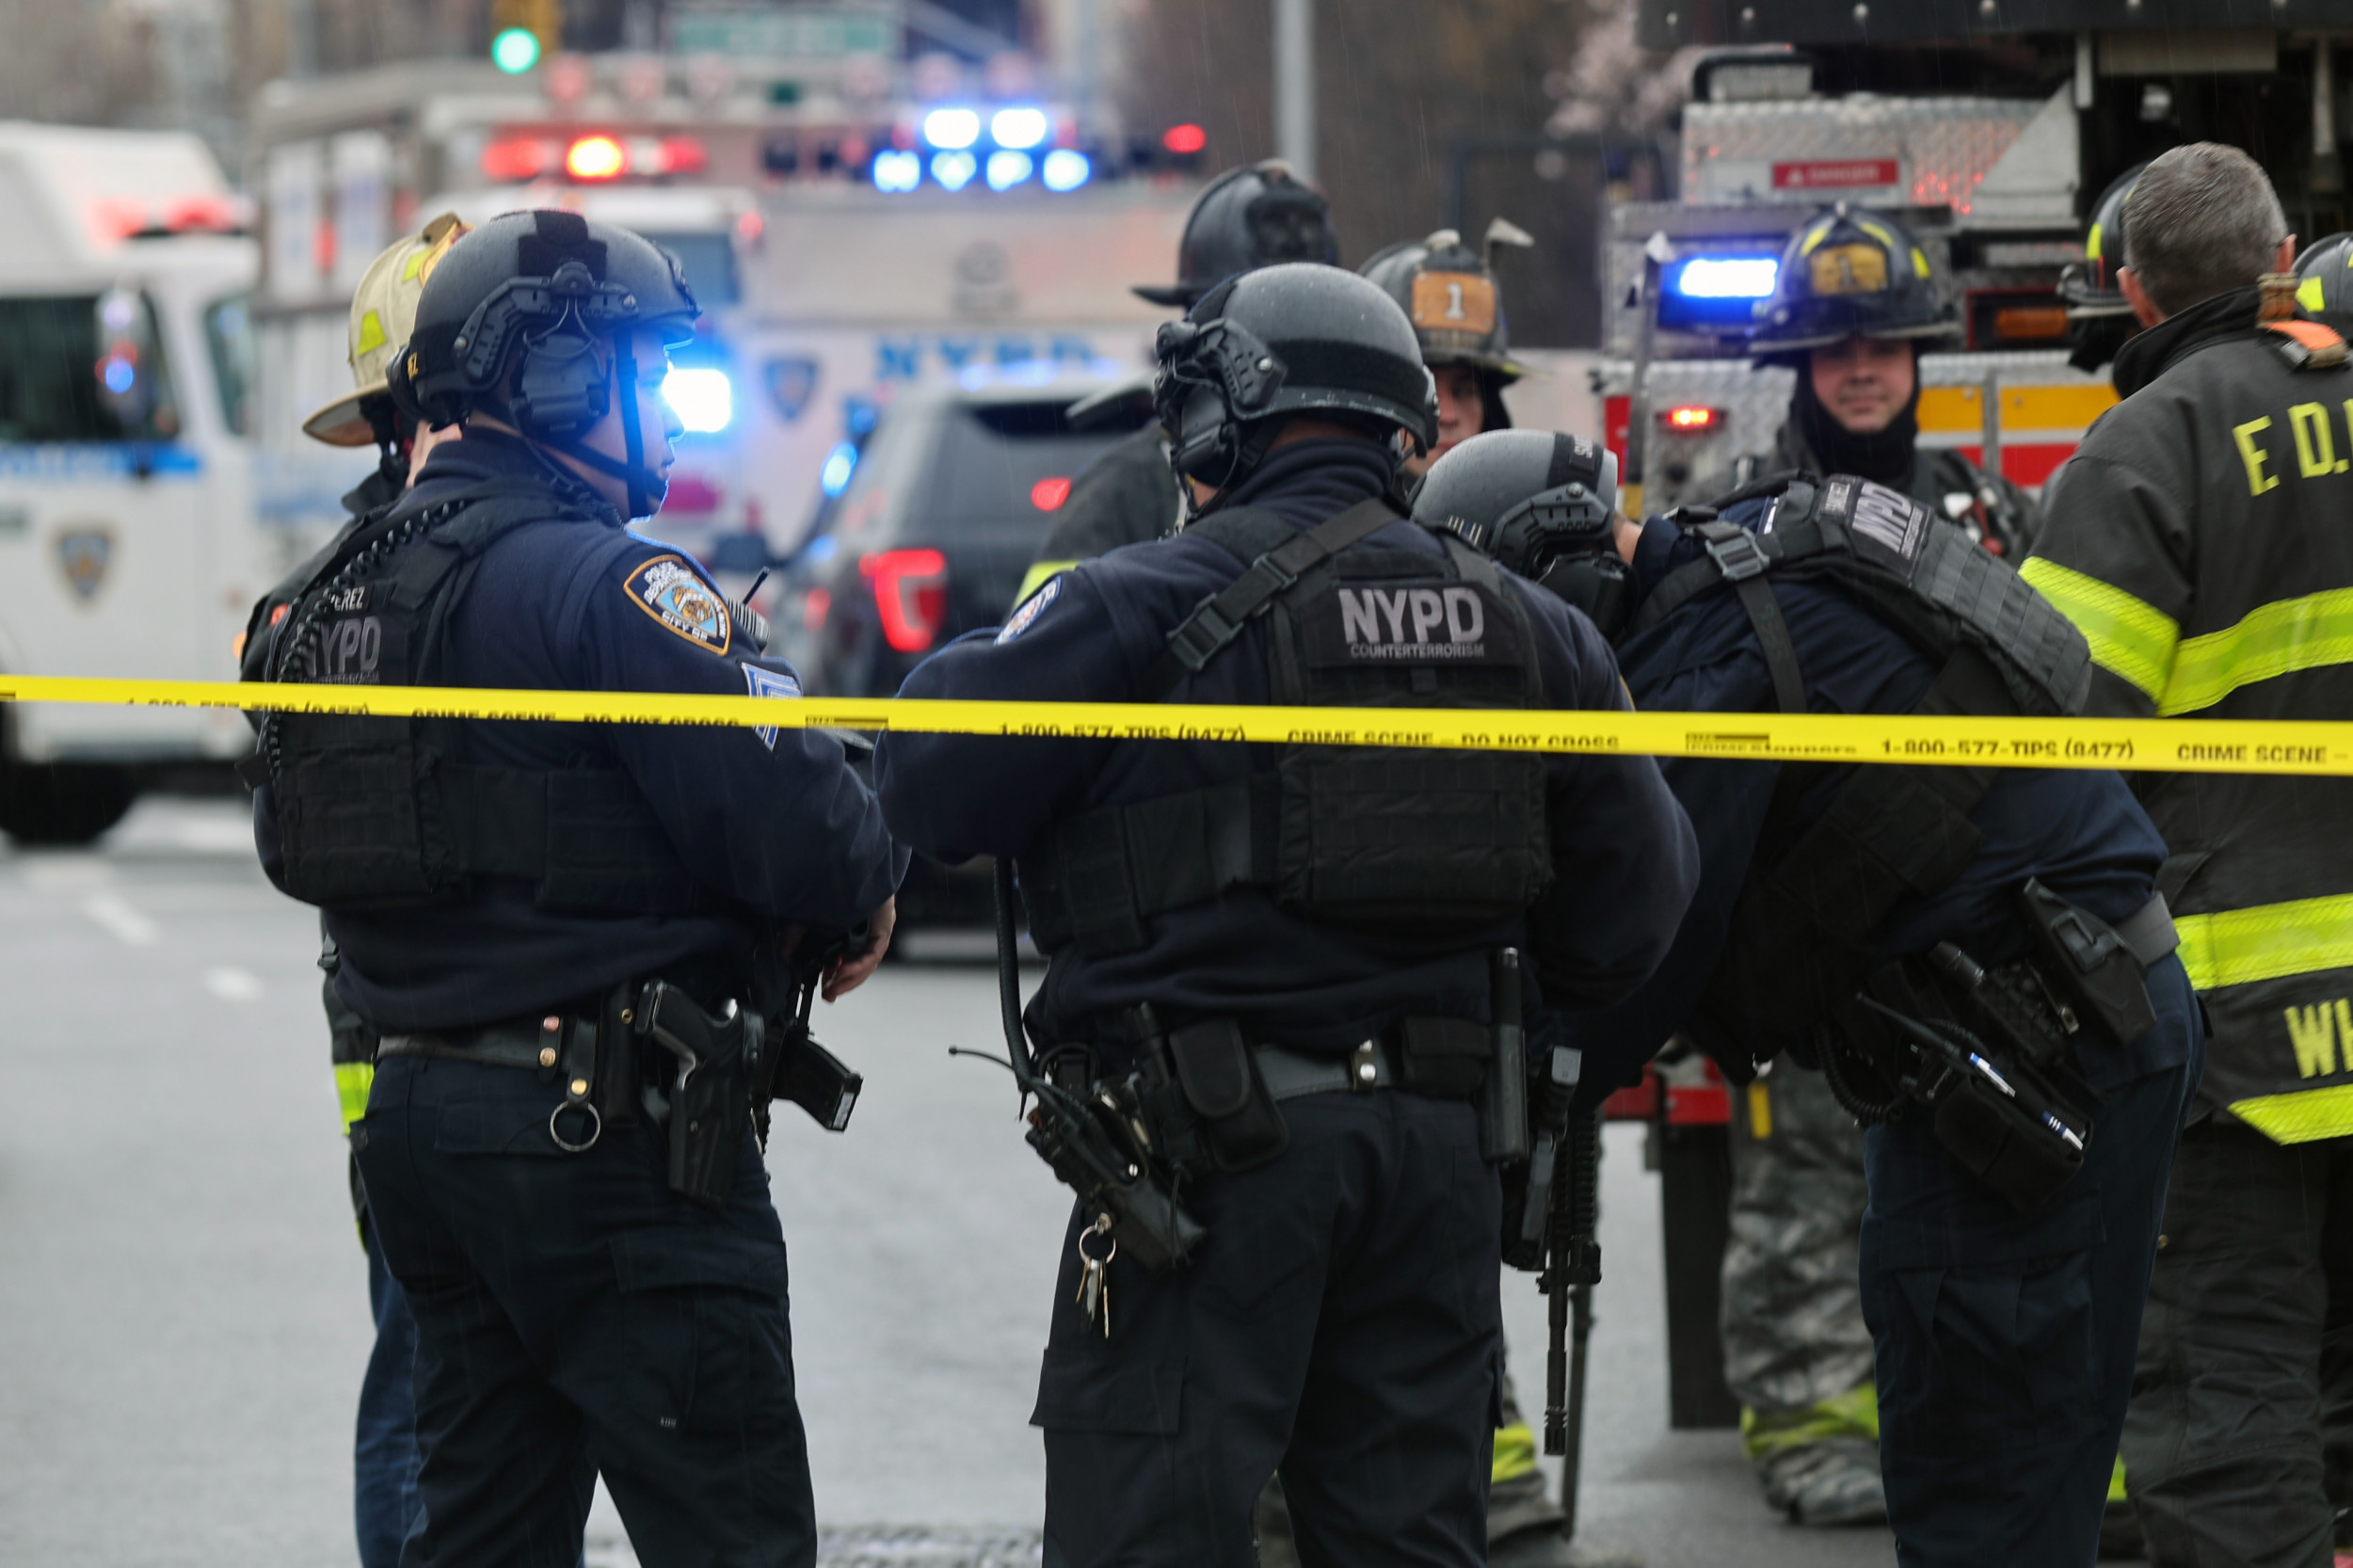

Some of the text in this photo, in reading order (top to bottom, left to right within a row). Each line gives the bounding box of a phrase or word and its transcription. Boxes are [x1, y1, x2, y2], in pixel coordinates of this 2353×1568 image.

[1444, 282, 1465, 320] 1
[1852, 481, 1913, 554] NYPD
[326, 586, 365, 612] EREZ
[1338, 587, 1484, 644] NYPD
[1350, 643, 1484, 658] COUNTERTERRORISM
[1287, 729, 1356, 744] CRIME
[1364, 731, 1433, 747] SCENE
[1462, 733, 1490, 748] DO
[1498, 734, 1541, 750] NOT
[1882, 738, 2057, 758] 1-800-577-TIPS
[2065, 738, 2135, 760] (8477)
[2177, 744, 2248, 762] CRIME
[2255, 744, 2328, 764] SCENE
